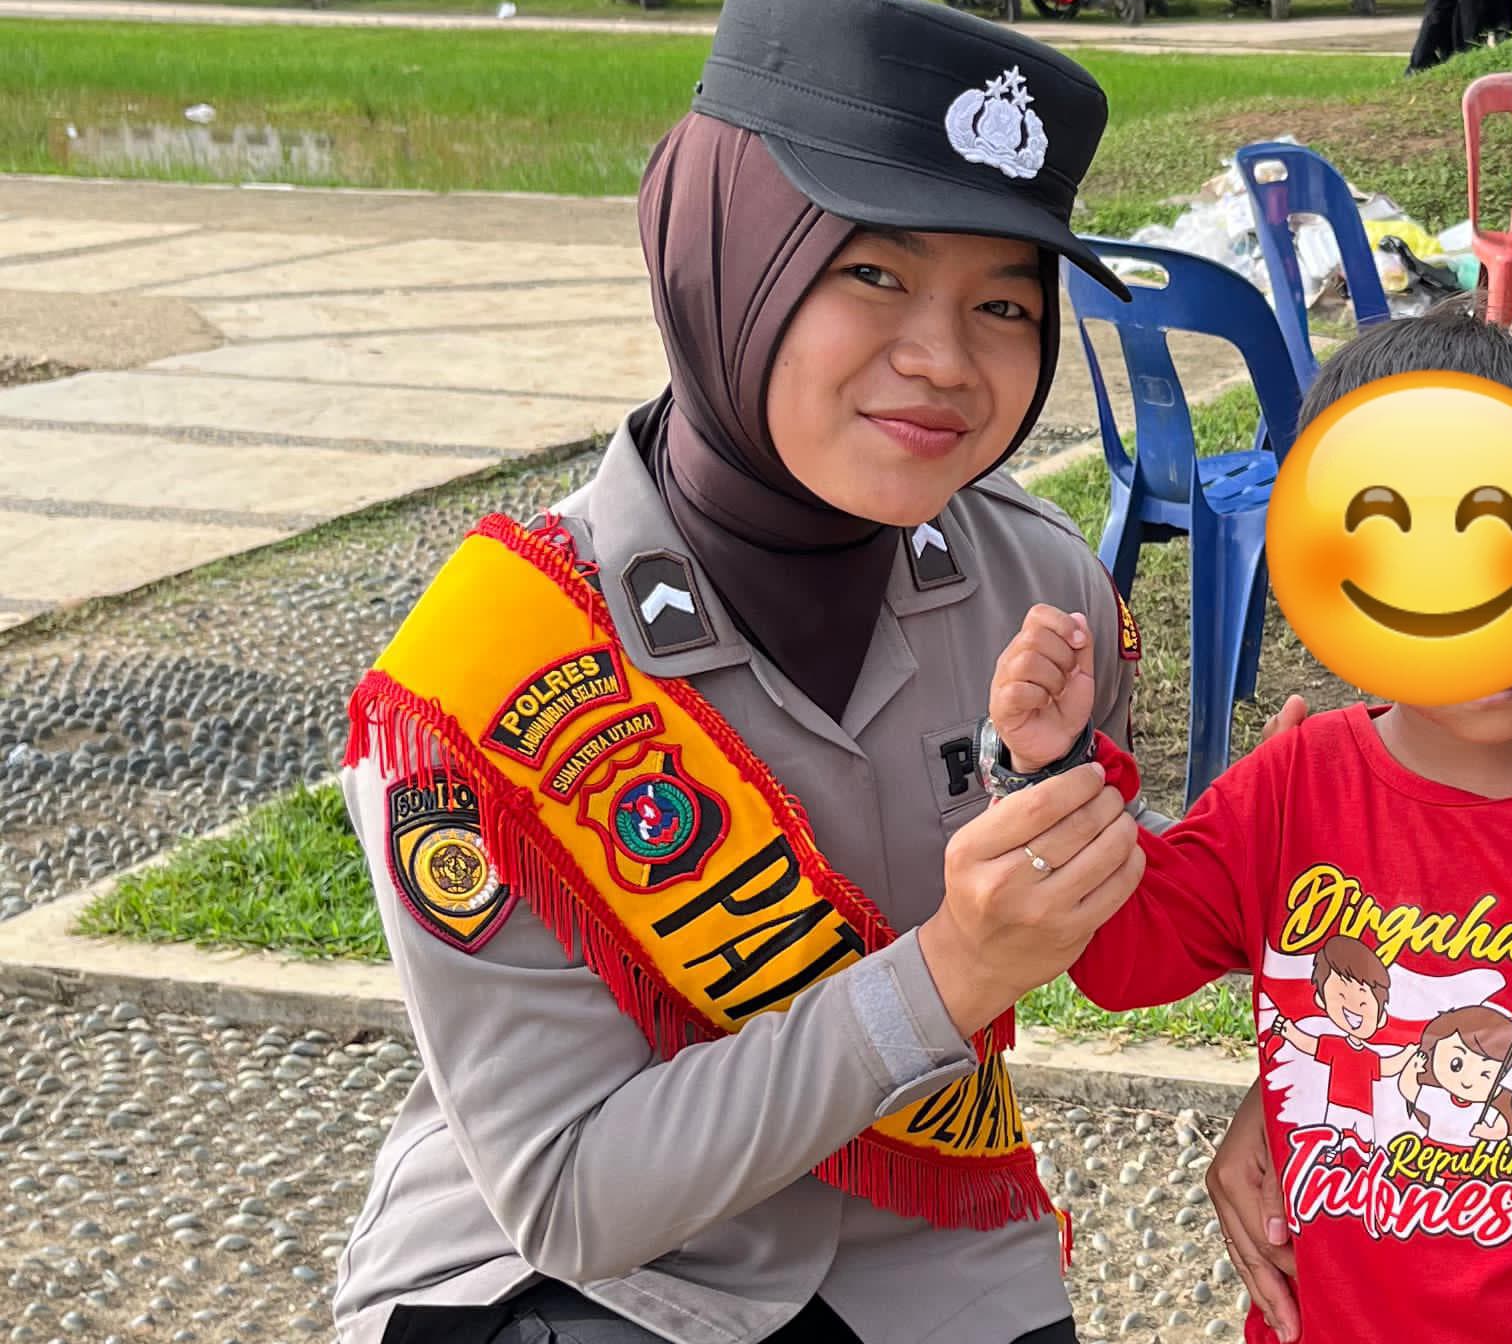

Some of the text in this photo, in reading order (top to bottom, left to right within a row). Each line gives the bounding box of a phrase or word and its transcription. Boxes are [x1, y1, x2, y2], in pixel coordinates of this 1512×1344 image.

[500, 655, 600, 736] POLRES
[516, 675, 619, 756] LABUHANBATU SELATAN
[552, 714, 654, 793] SUMATERA UTARA
